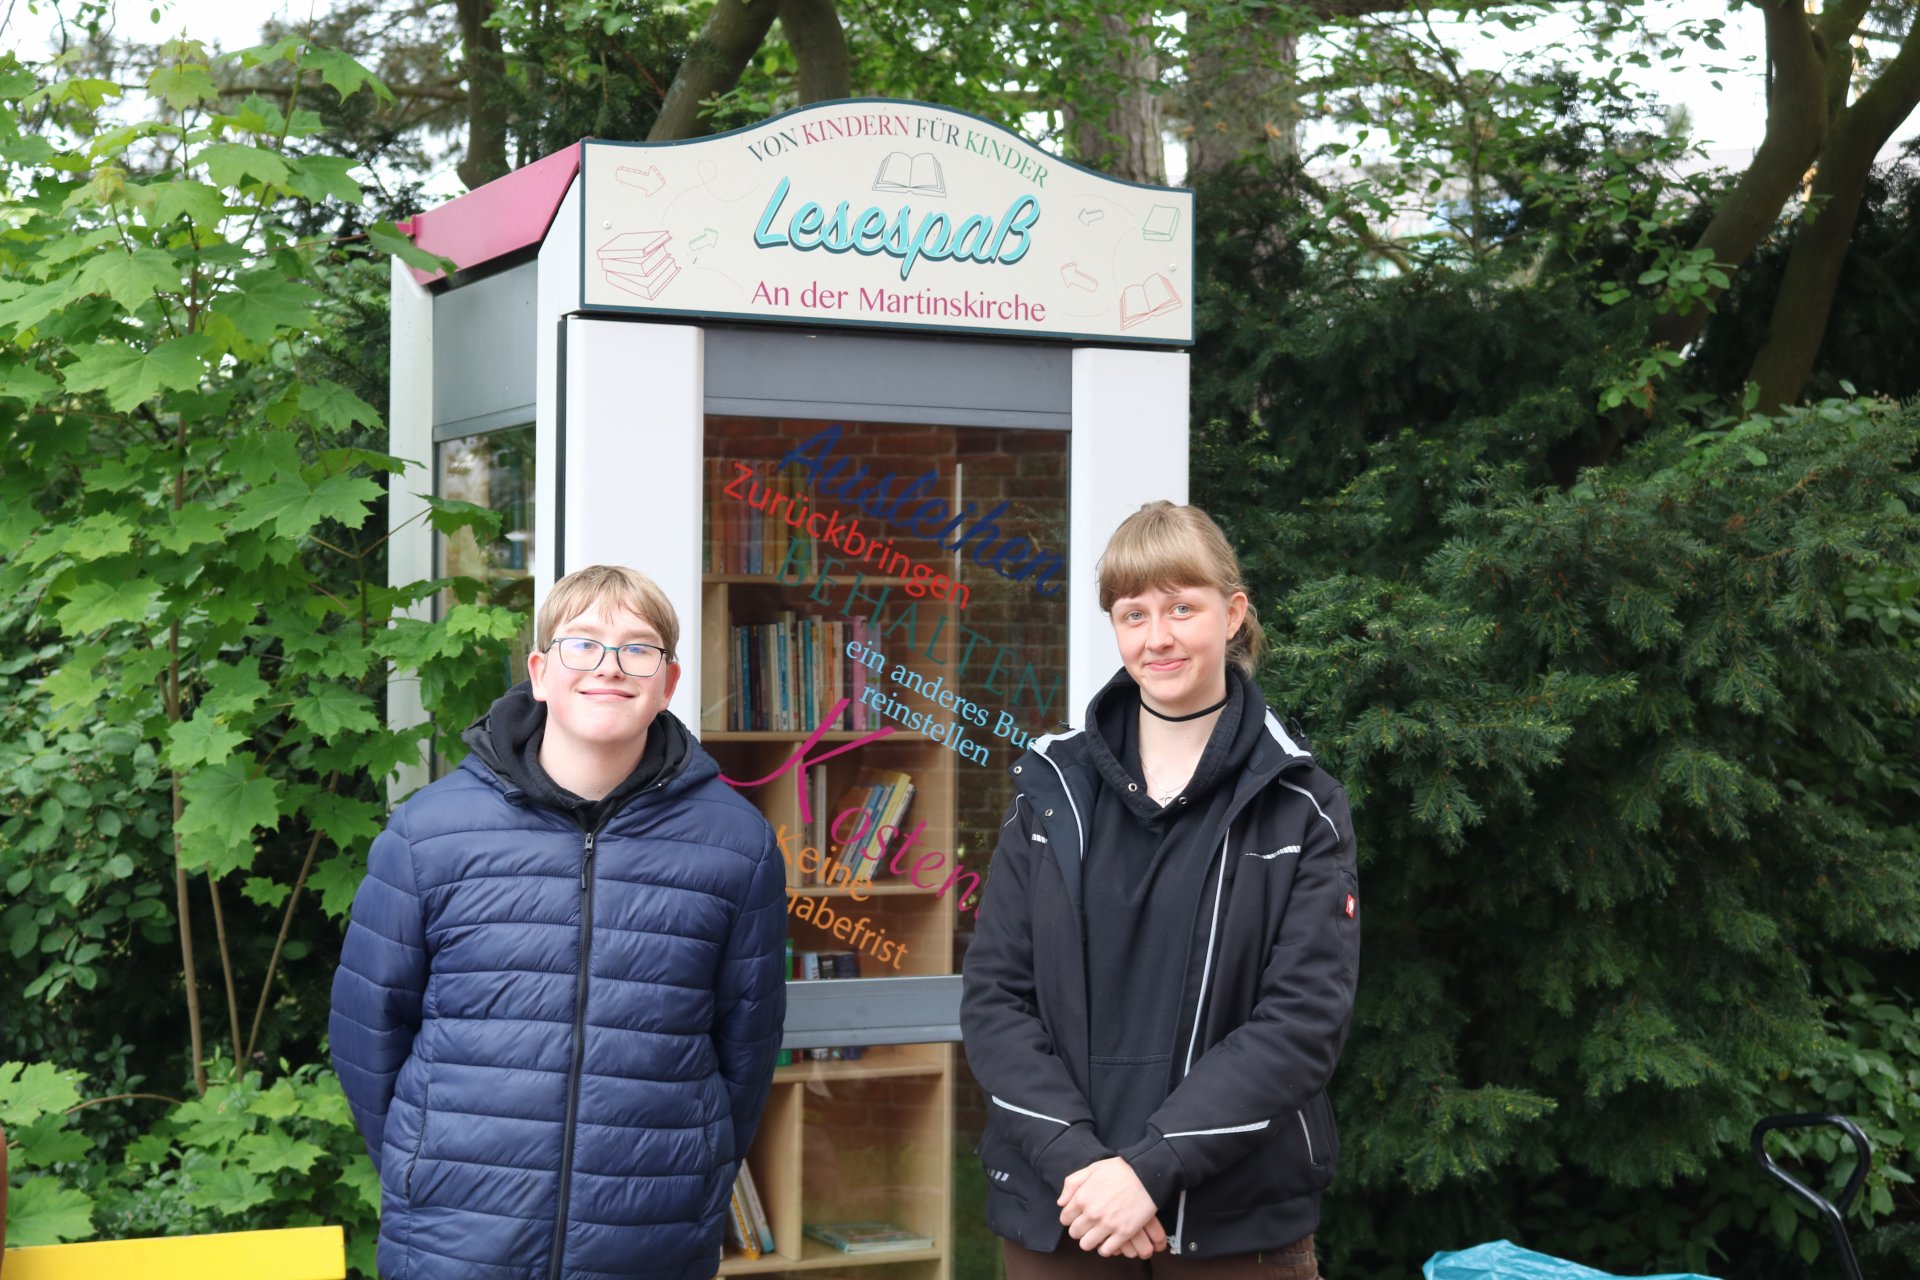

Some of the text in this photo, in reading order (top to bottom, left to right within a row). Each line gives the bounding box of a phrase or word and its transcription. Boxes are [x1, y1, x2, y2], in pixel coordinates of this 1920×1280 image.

[747, 115, 1049, 188] VON KINDERN FÜR KINDER
[754, 174, 1040, 281] Lesespaß
[751, 281, 1047, 322] An der Martinskirche
[723, 462, 971, 610] Zurückbringen
[774, 424, 1065, 597] Ausleihen
[776, 536, 1062, 718] BEHALTEN
[846, 639, 887, 674] ein
[890, 664, 989, 727] anderes
[858, 685, 990, 767] reinstellen
[718, 697, 981, 921] Kosten
[776, 824, 874, 902] Keine
